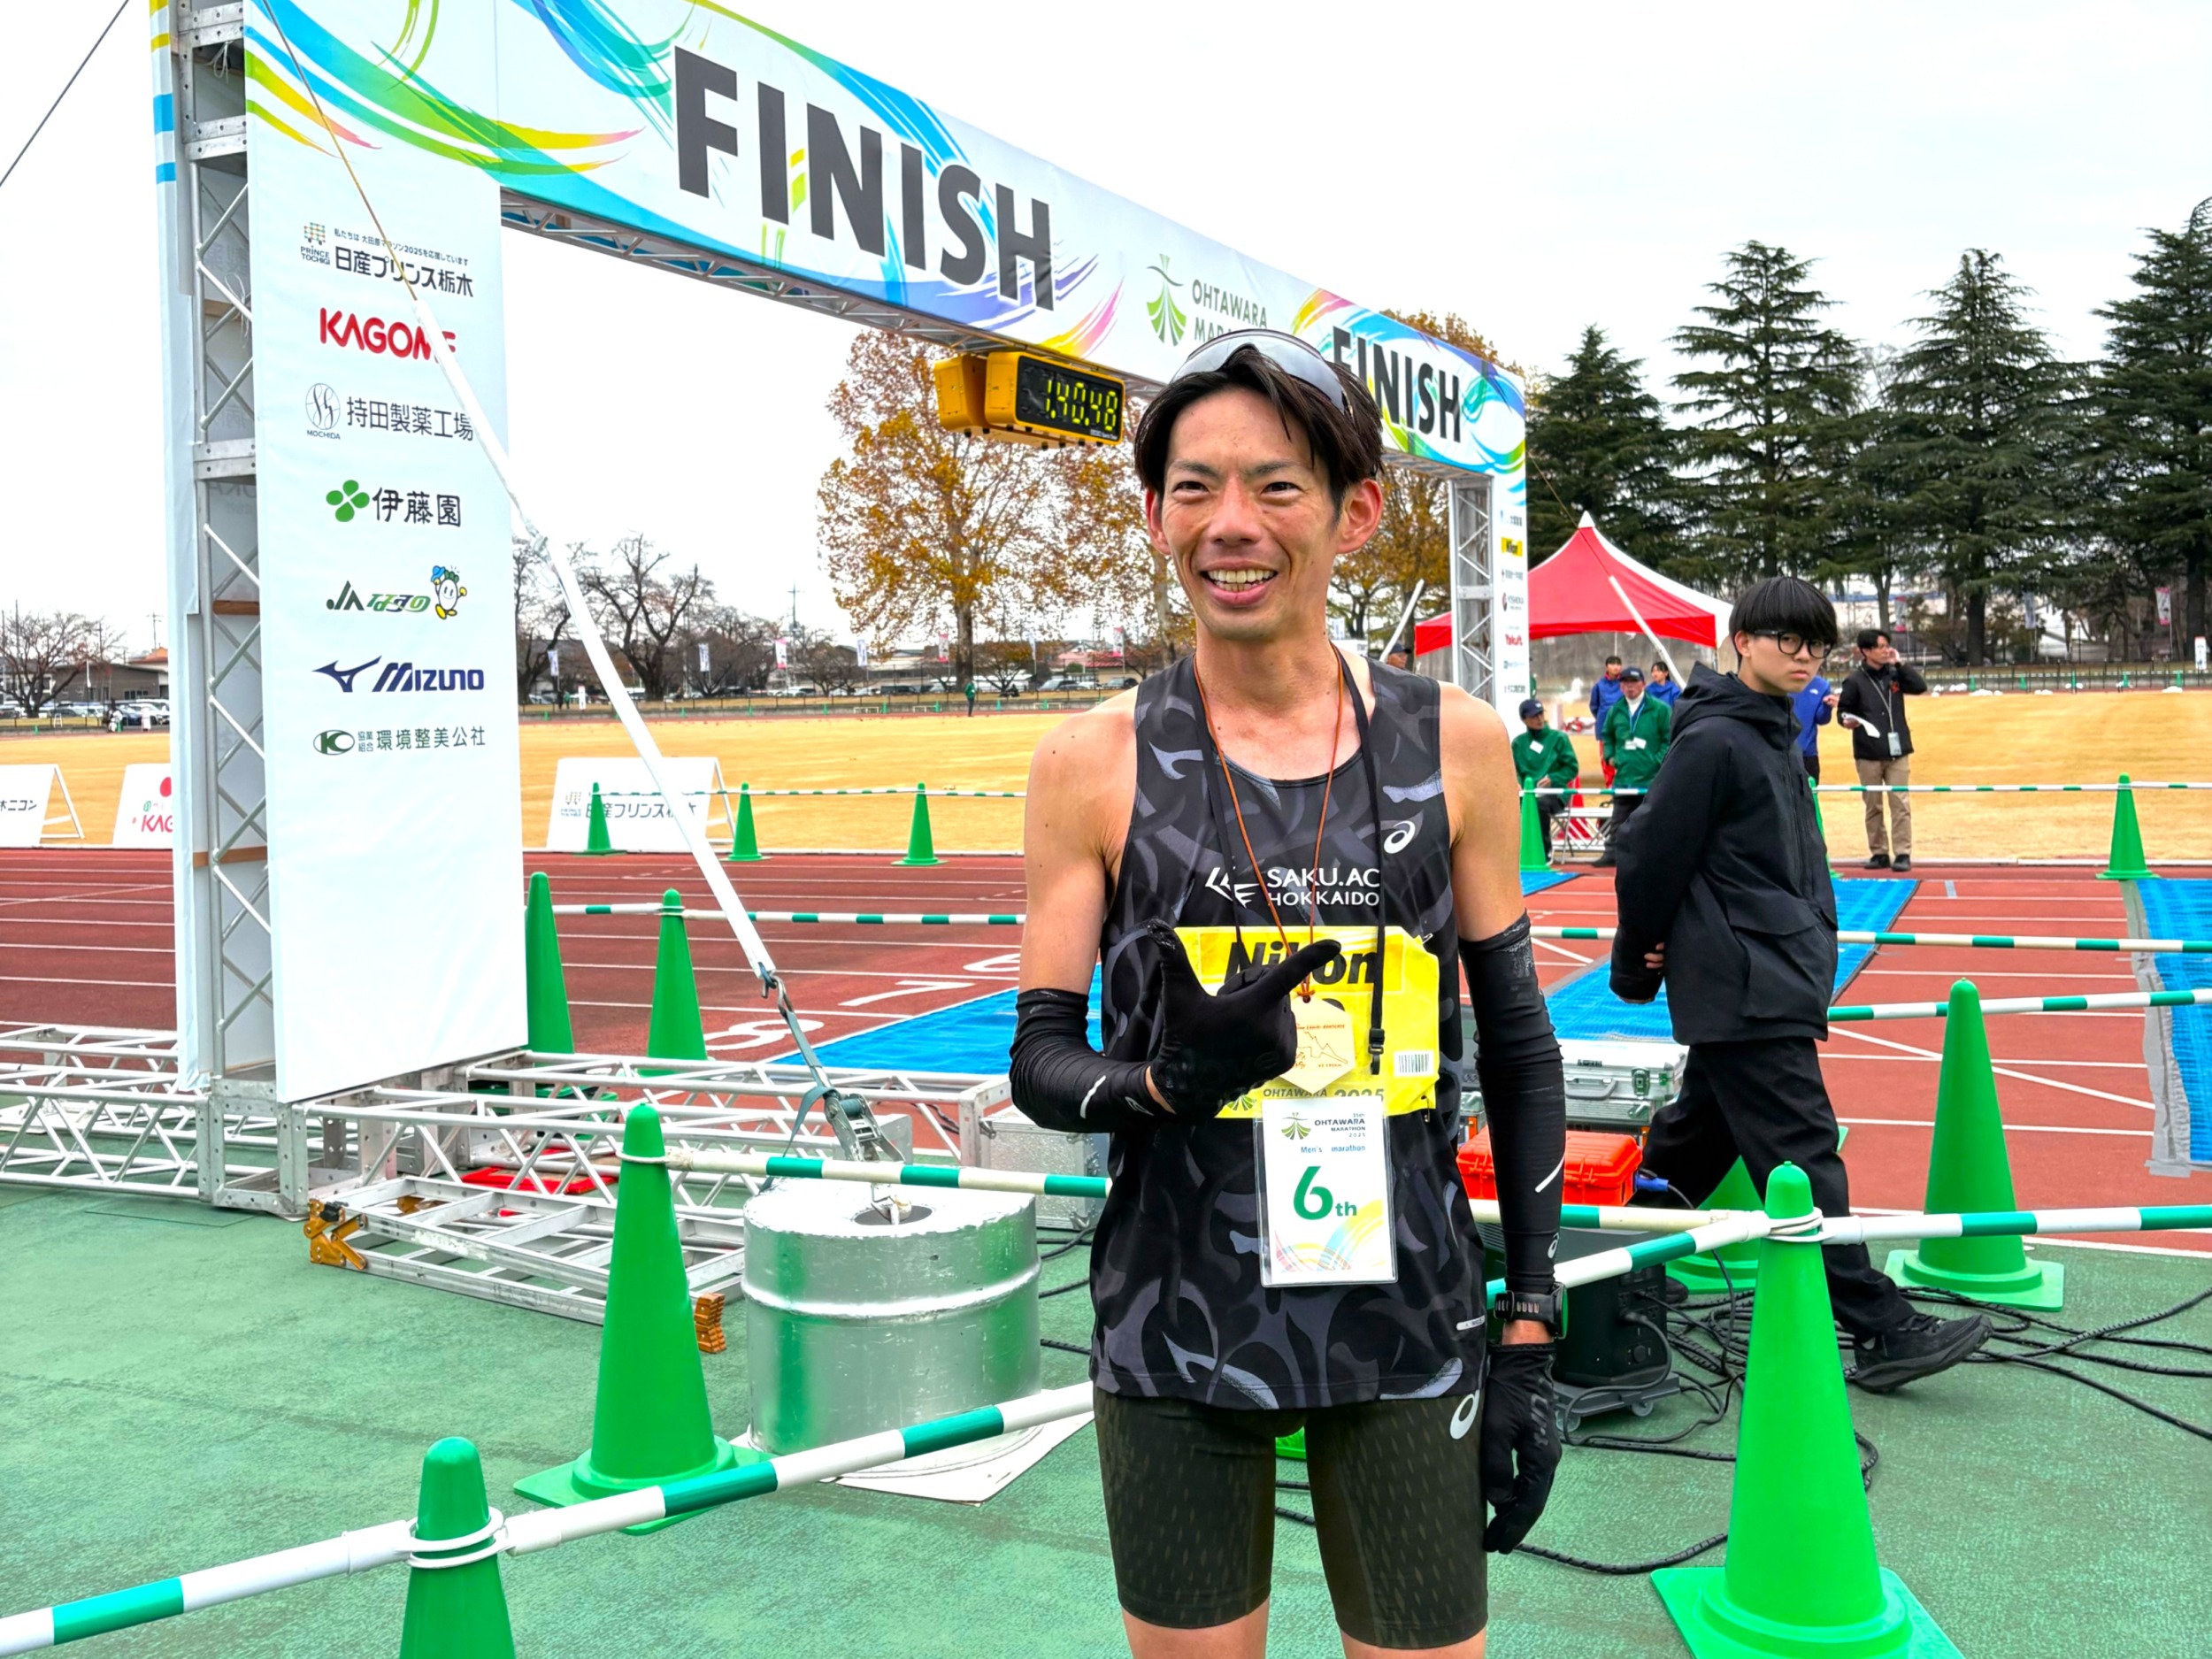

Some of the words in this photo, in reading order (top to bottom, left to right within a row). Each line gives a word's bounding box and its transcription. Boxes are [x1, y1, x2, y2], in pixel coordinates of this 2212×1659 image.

[674, 46, 1054, 311] FINISH
[335, 246, 473, 297] 日産プリンス栃木
[1192, 279, 1267, 329] OHTAWARA
[307, 430, 341, 440] MOCHIDA
[347, 396, 473, 441] 持田製薬工場
[372, 488, 461, 527] 伊藤園
[376, 726, 486, 751] 環境整美公社
[1268, 892, 1379, 907] HOKKAIDO
[1224, 941, 1377, 985] Nion
[1331, 1144, 1365, 1153] marathon
[1293, 1165, 1357, 1220] 6th
